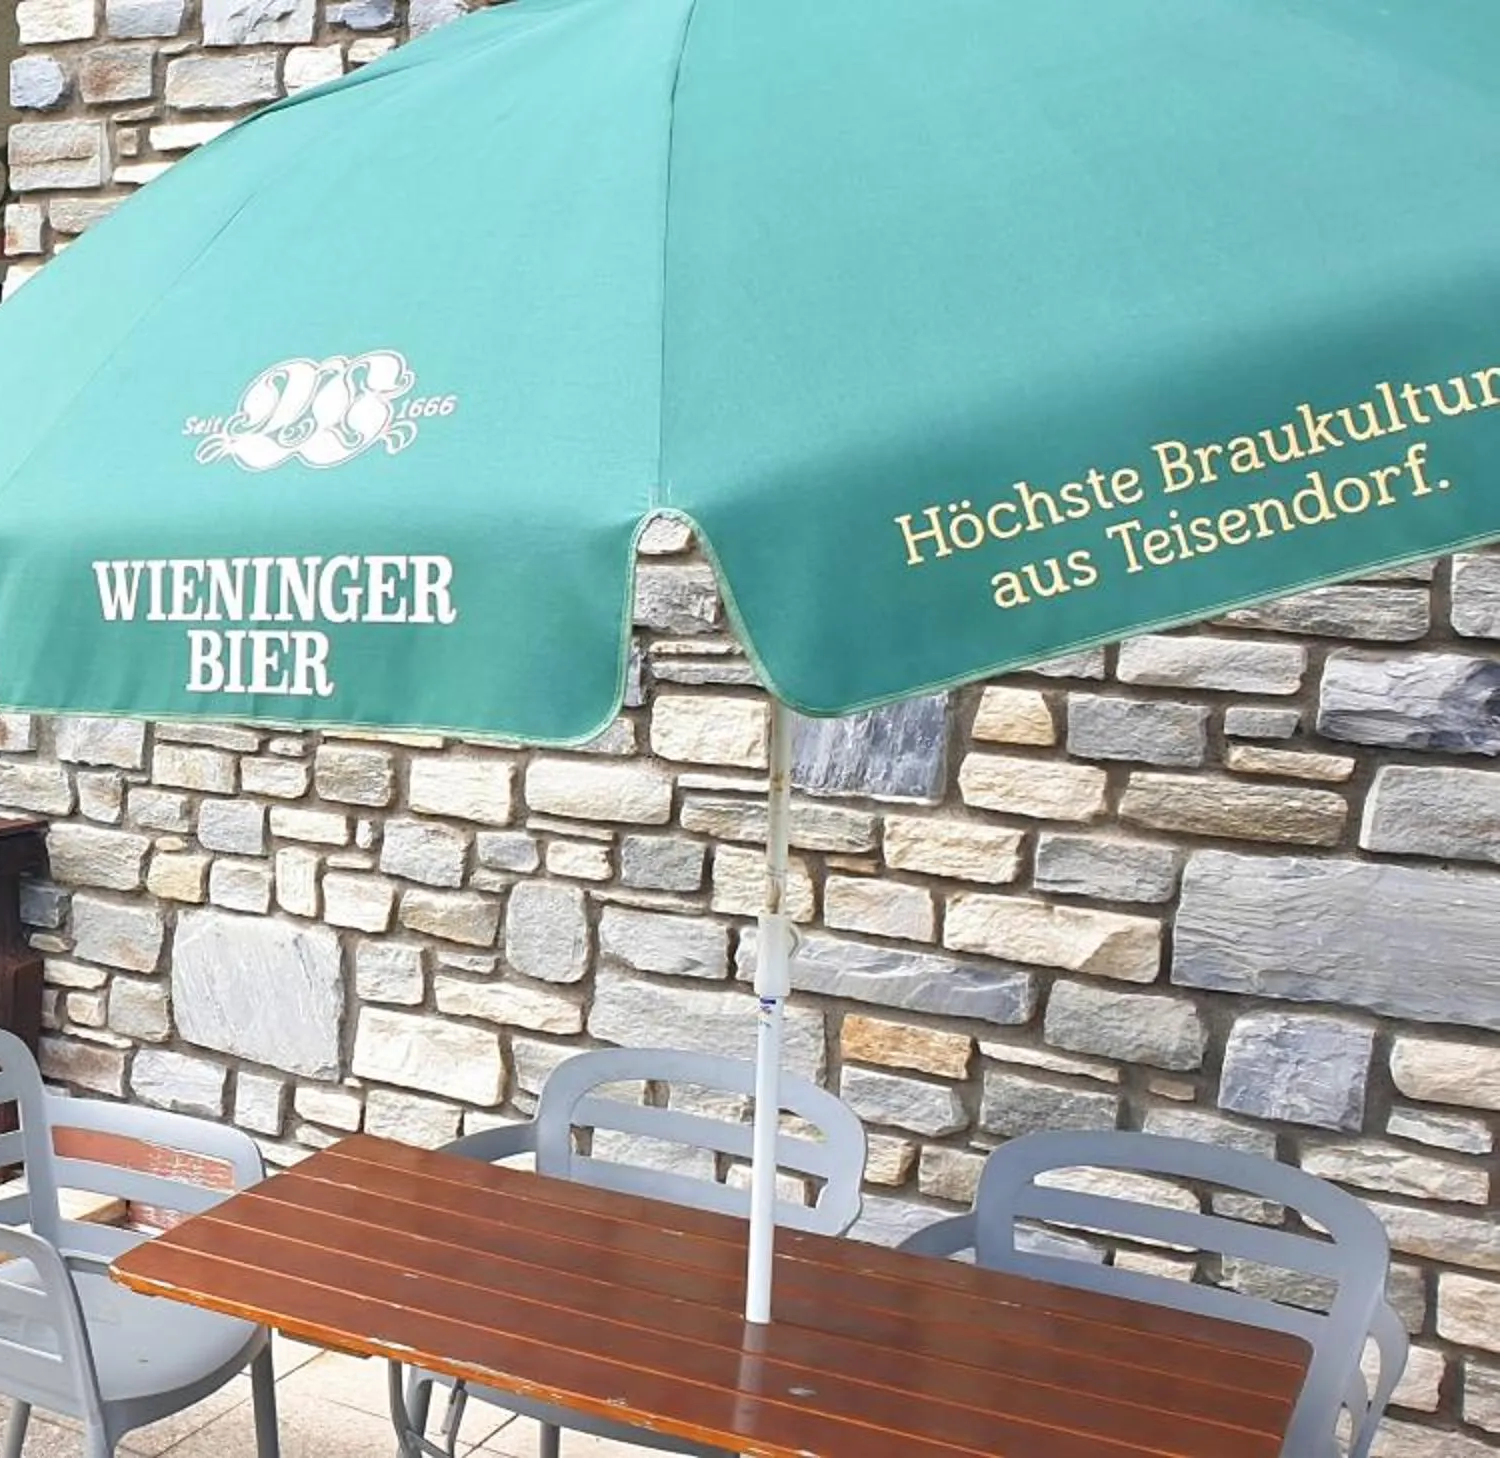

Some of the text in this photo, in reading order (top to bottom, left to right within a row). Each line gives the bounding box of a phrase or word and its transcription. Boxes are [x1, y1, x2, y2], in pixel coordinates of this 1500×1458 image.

[182, 416, 222, 437] Seit
[396, 395, 457, 420] 1666
[895, 366, 1500, 566] Höchste Braukultur
[990, 443, 1451, 609] aus Teisendorf.
[92, 554, 457, 625] WIENINGER
[186, 628, 334, 697] BIER
